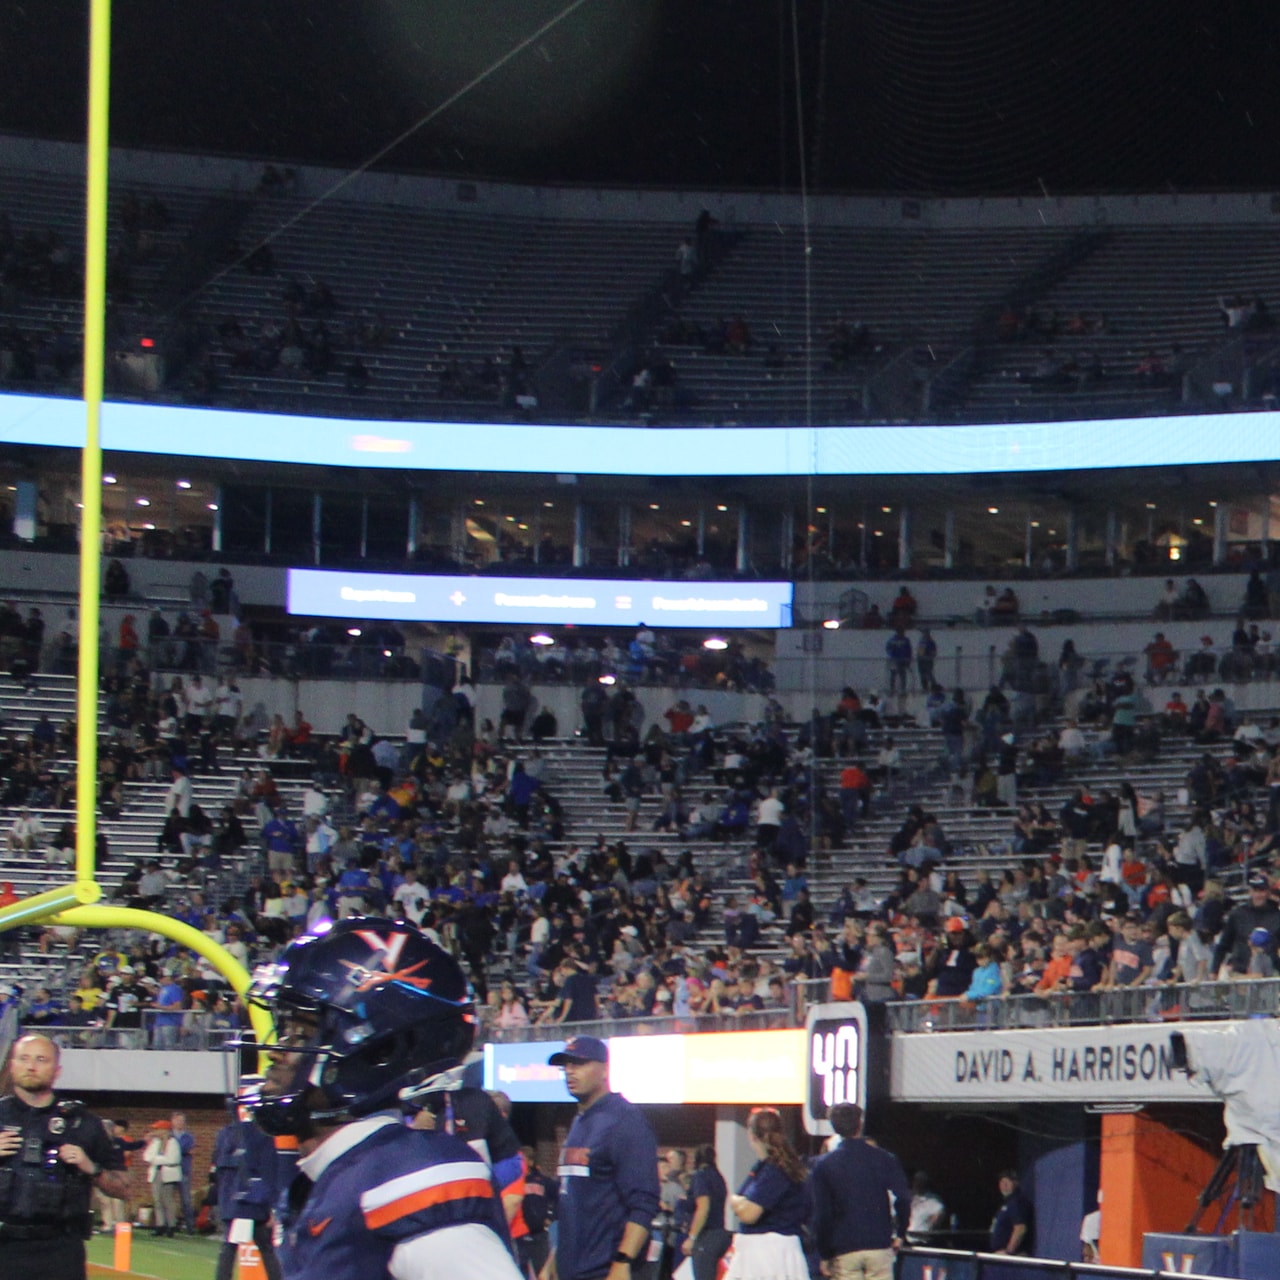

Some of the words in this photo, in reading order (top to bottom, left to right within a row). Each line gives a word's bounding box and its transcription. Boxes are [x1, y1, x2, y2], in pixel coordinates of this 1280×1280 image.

[955, 1049, 1014, 1083] DAVID
[1023, 1052, 1043, 1082] A.
[1052, 1043, 1173, 1082] HARRISON
